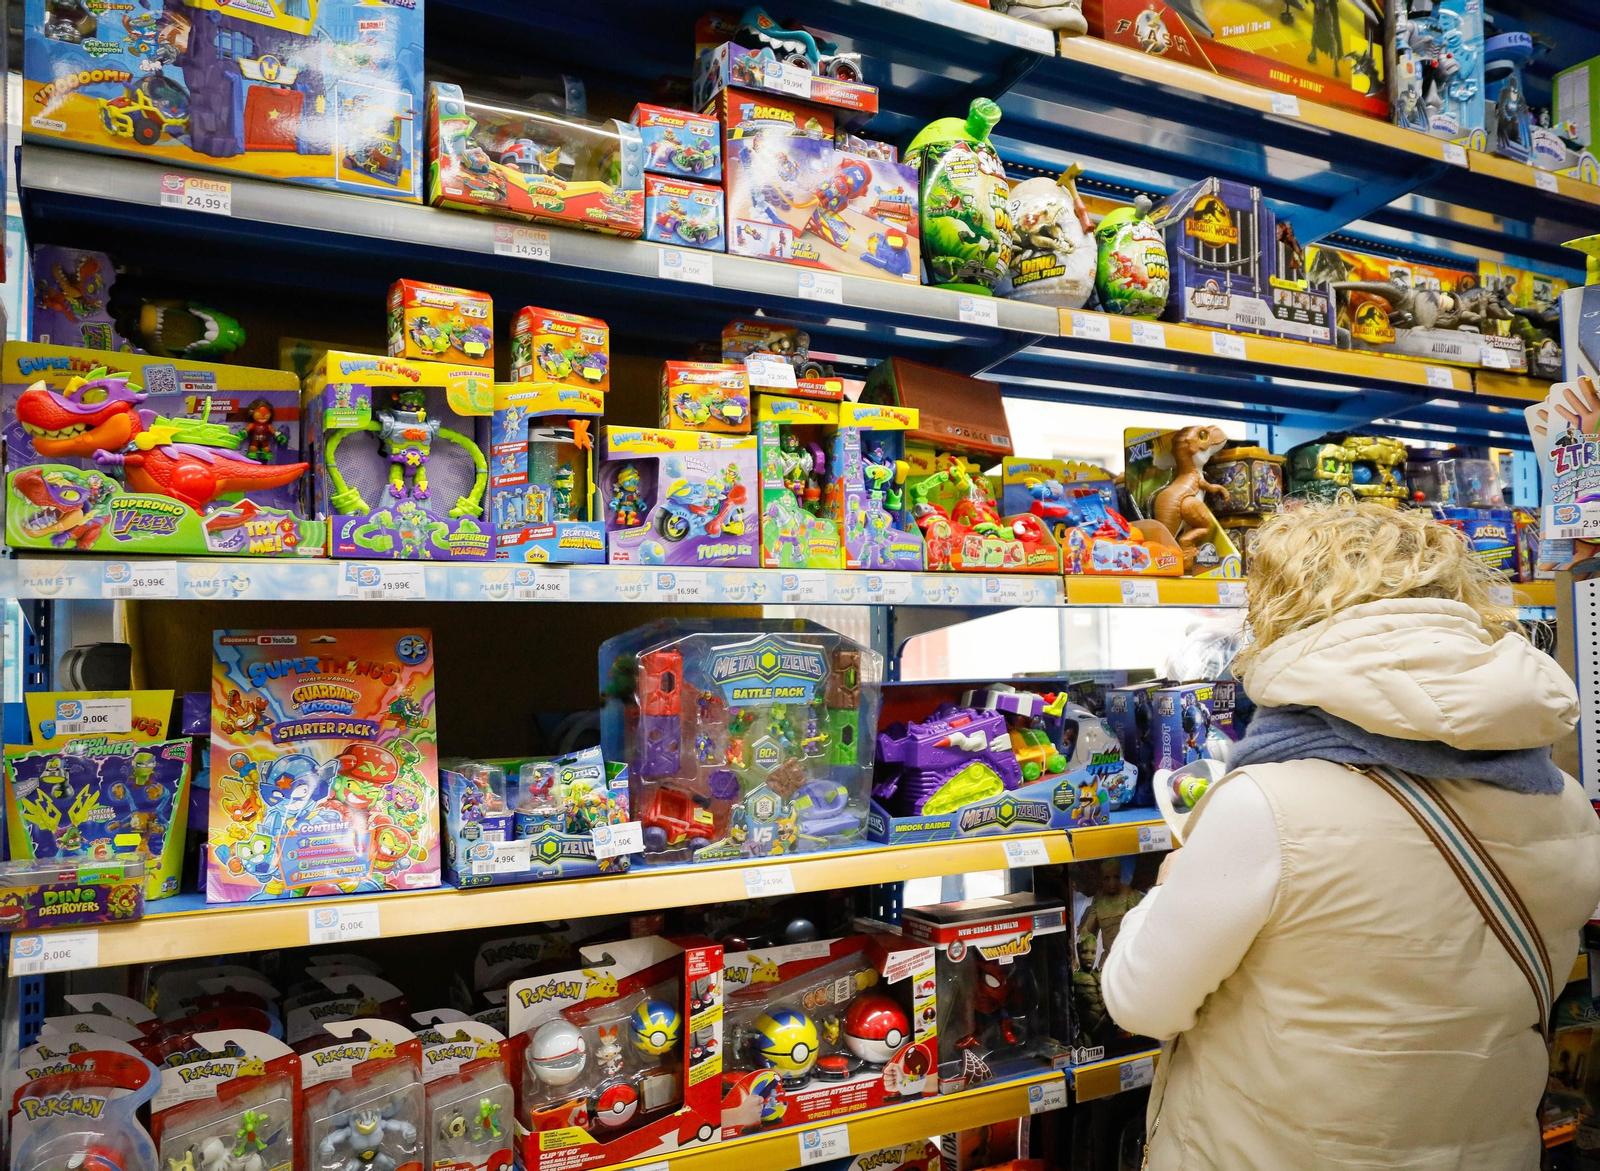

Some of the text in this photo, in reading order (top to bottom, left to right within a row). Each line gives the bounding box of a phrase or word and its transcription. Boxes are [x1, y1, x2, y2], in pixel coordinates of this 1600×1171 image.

[739, 103, 795, 122] T-RACERS
[189, 178, 227, 192] Oferta
[536, 187, 557, 196] SPEED
[186, 196, 222, 210] 24,99
[516, 229, 547, 241] Oferta
[1215, 226, 1238, 239] WORLD
[515, 244, 544, 257] 14,99
[791, 241, 804, 250] HIT
[791, 249, 820, 261] LAUNCH!
[1013, 270, 1041, 286] FOSSIL
[1235, 313, 1267, 327] PYRORAPTOR
[542, 319, 578, 335] T-RACERS
[1431, 342, 1463, 355] ALLOSAURUS
[449, 370, 491, 379] FLEXIBLE ARMS
[193, 383, 214, 391] YouTube
[798, 381, 815, 389] MEGA
[507, 390, 539, 401] CONTENT
[1128, 442, 1152, 463] XL
[1551, 441, 1600, 475] ZTR
[111, 498, 185, 515] SUPERDINO
[114, 509, 178, 536] V-REX
[244, 520, 273, 537] TRY
[449, 533, 492, 544] SUPERBOT
[561, 528, 602, 540] SECRET BASE
[218, 533, 246, 550] PRESS
[249, 535, 283, 555] ME!
[504, 537, 518, 545] BASE
[449, 547, 488, 558] TRASHER
[697, 543, 753, 559] TURBO ICE
[22, 576, 75, 588] PLANET
[132, 577, 166, 588] 36,99€
[183, 578, 230, 589] PLANET
[382, 581, 411, 591] 19,99€
[535, 582, 561, 592] 24,90€
[614, 583, 650, 593] PLANET
[676, 587, 699, 595] 16,99€
[272, 636, 295, 645] YouTube
[712, 654, 756, 679] META
[328, 676, 356, 684] KABOOM
[293, 684, 361, 704] GUARDIANS
[732, 686, 805, 700] BATTLE PACK
[301, 701, 353, 716] KAZOOM
[82, 714, 109, 724] 9,00€
[1210, 711, 1233, 721] ROBOT
[279, 721, 372, 739] STARTER PACK
[86, 742, 135, 757] POWER
[758, 747, 777, 759] 80+
[1091, 752, 1121, 765] DINO
[1087, 761, 1124, 775] BYTES
[1061, 780, 1068, 790] 2
[88, 806, 115, 816] SPECIAL
[87, 813, 117, 822] ATTACKS
[961, 807, 997, 828] META
[301, 822, 351, 834] CONTIENE
[894, 820, 951, 833] WROCK RAIDER
[753, 826, 773, 843] VS
[90, 837, 111, 847] PACK
[312, 838, 334, 846] COMIC
[613, 838, 632, 847] 1,50€
[93, 844, 107, 860] 6
[311, 856, 356, 867] SUPERTHINGS
[494, 855, 516, 864] 4,99€
[342, 866, 364, 875] METAL
[43, 888, 97, 906] DINO
[38, 902, 101, 918] DESTROYERS
[340, 921, 364, 931] 6,00€
[958, 921, 1019, 937] ULTIMATE SPIDER-MAN
[43, 950, 72, 961] 8,00€
[1087, 1047, 1104, 1058] TITAN
[796, 1090, 829, 1103] SURPRISE
[829, 1085, 855, 1096] ATTACK
[855, 1081, 876, 1092] GAME
[813, 1110, 831, 1119] PIECES!
[539, 1151, 556, 1160] CLIP
